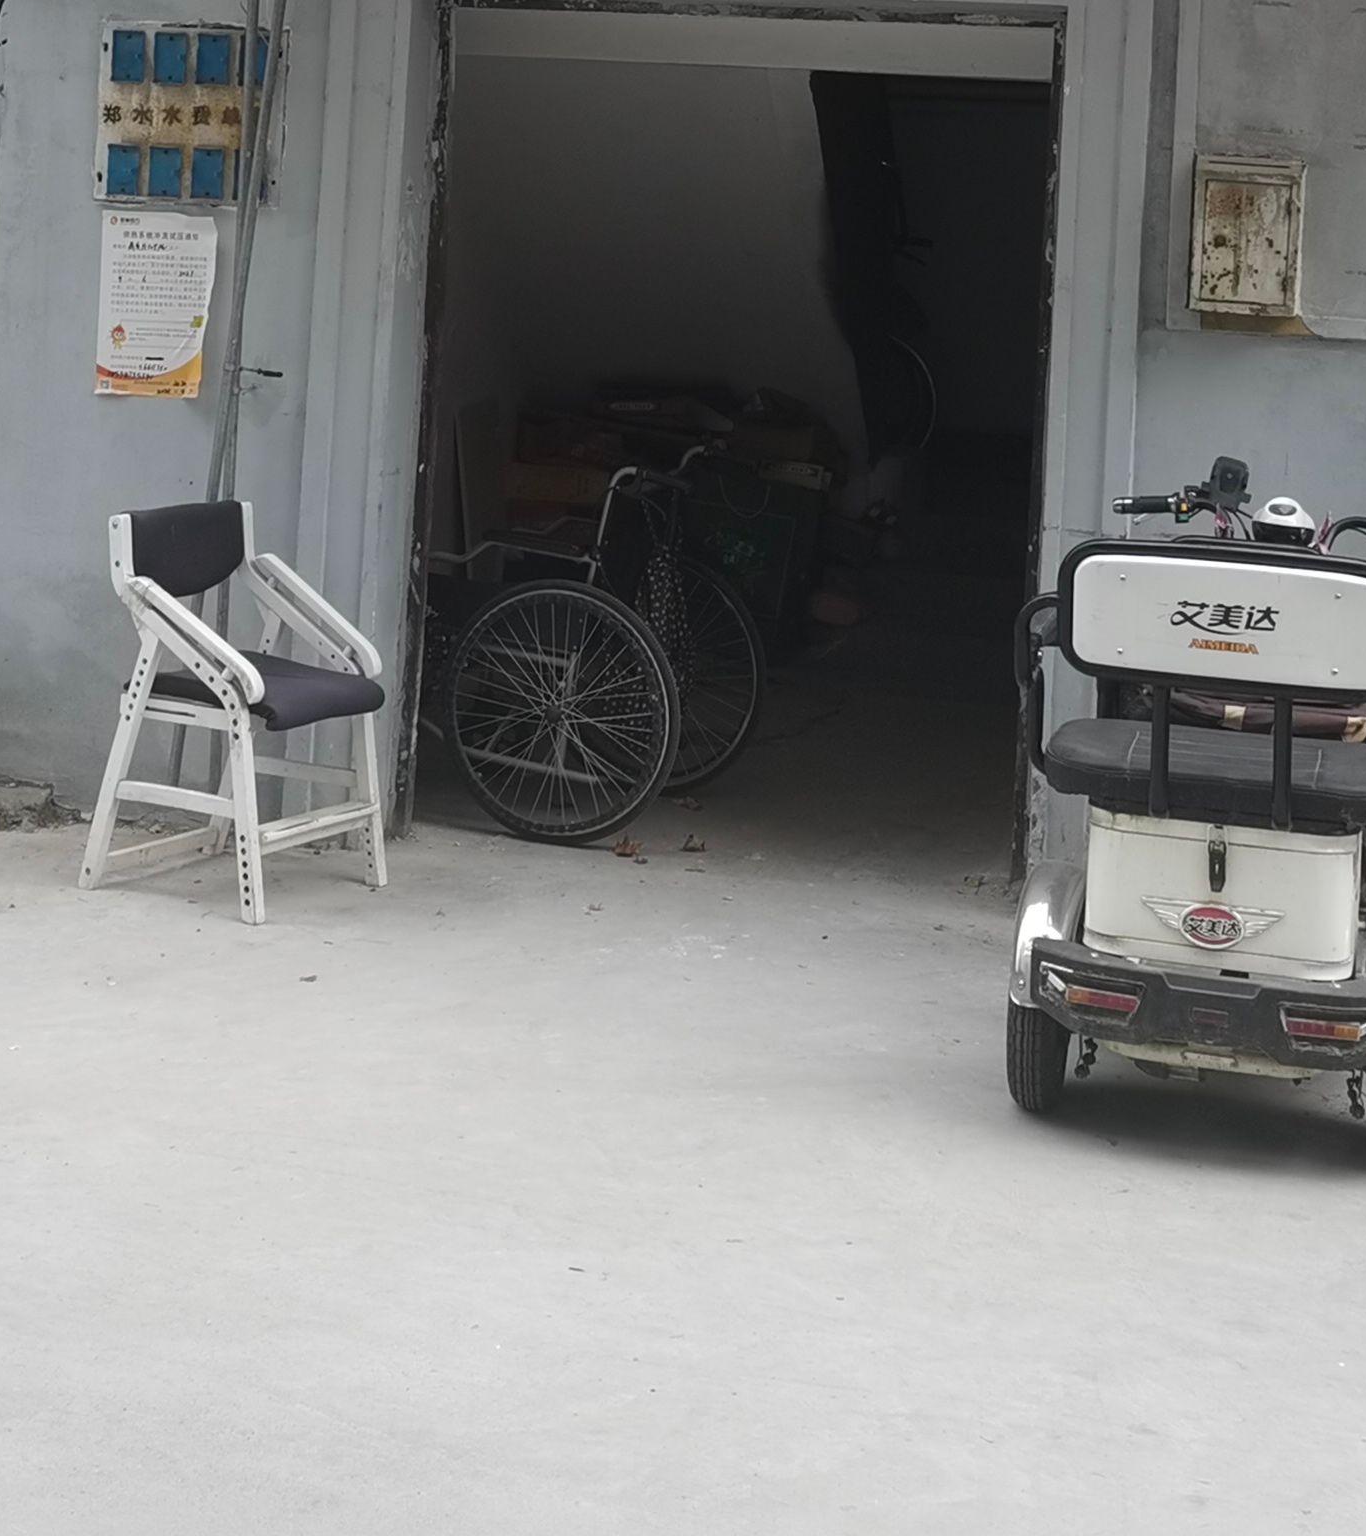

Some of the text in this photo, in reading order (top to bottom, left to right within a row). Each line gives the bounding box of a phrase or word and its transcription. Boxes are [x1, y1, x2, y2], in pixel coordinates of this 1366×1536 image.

[1170, 600, 1280, 636] 艾美达
[1182, 916, 1242, 937] 艾美达
